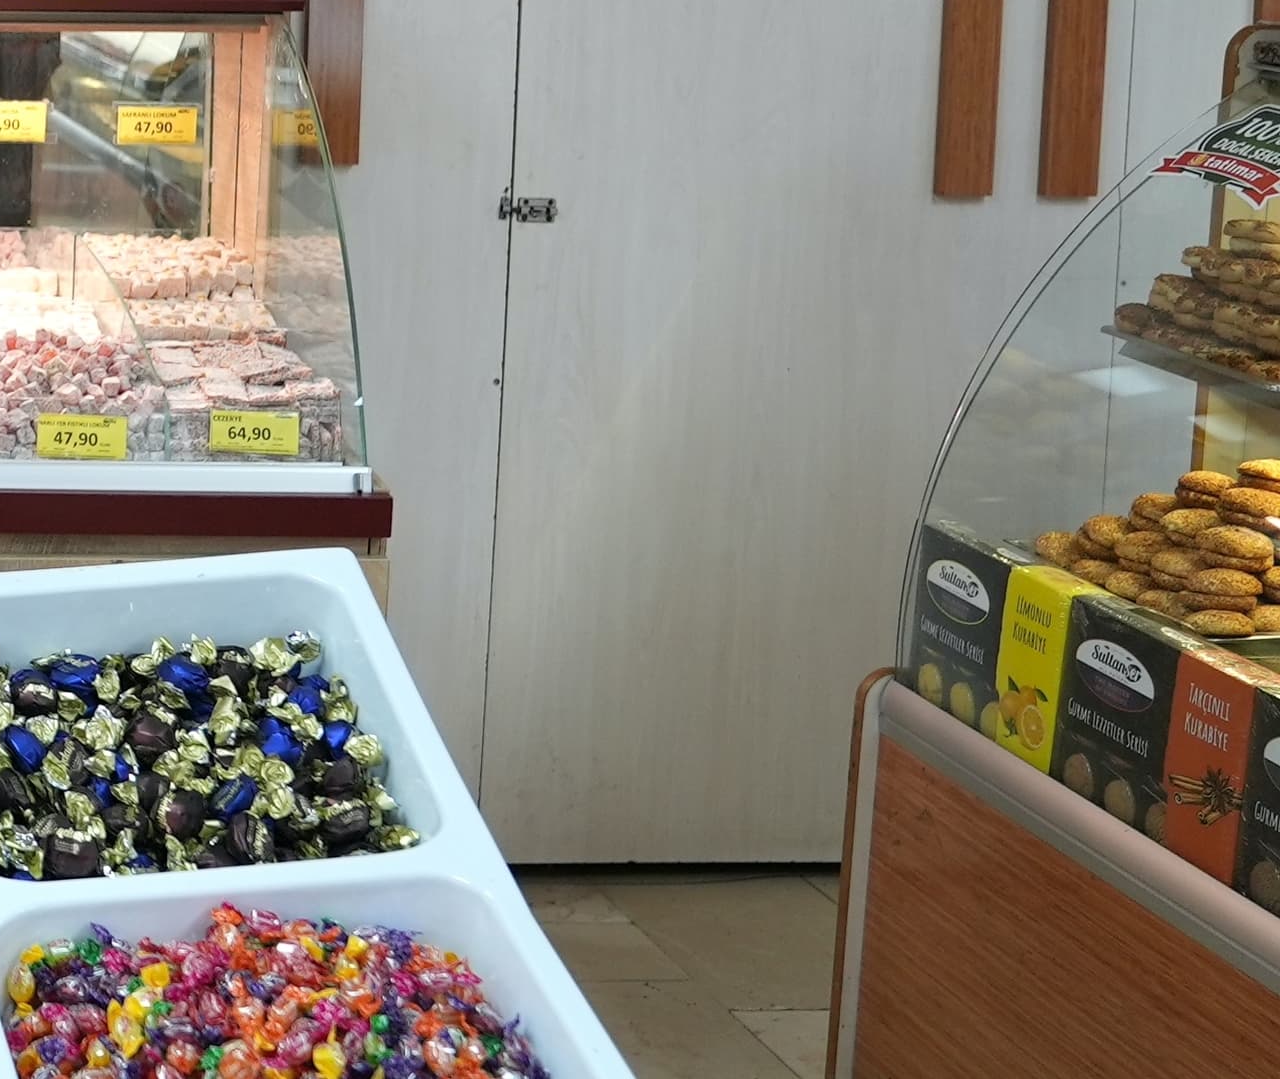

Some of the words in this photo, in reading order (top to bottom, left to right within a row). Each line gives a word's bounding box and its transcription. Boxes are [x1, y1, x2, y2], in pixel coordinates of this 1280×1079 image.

[134, 121, 173, 135] 47,90
[54, 432, 98, 447] 47,90
[228, 426, 271, 442] 64,90
[1016, 595, 1052, 629] LİMONLU
[1012, 624, 1046, 655] KURABİYE
[1188, 683, 1230, 721] TARÇINLI
[1067, 697, 1091, 724] GURME
[1092, 711, 1125, 745] LEZZETLER
[1126, 731, 1149, 758] SERİSİ
[1185, 712, 1228, 752] KURABİYE
